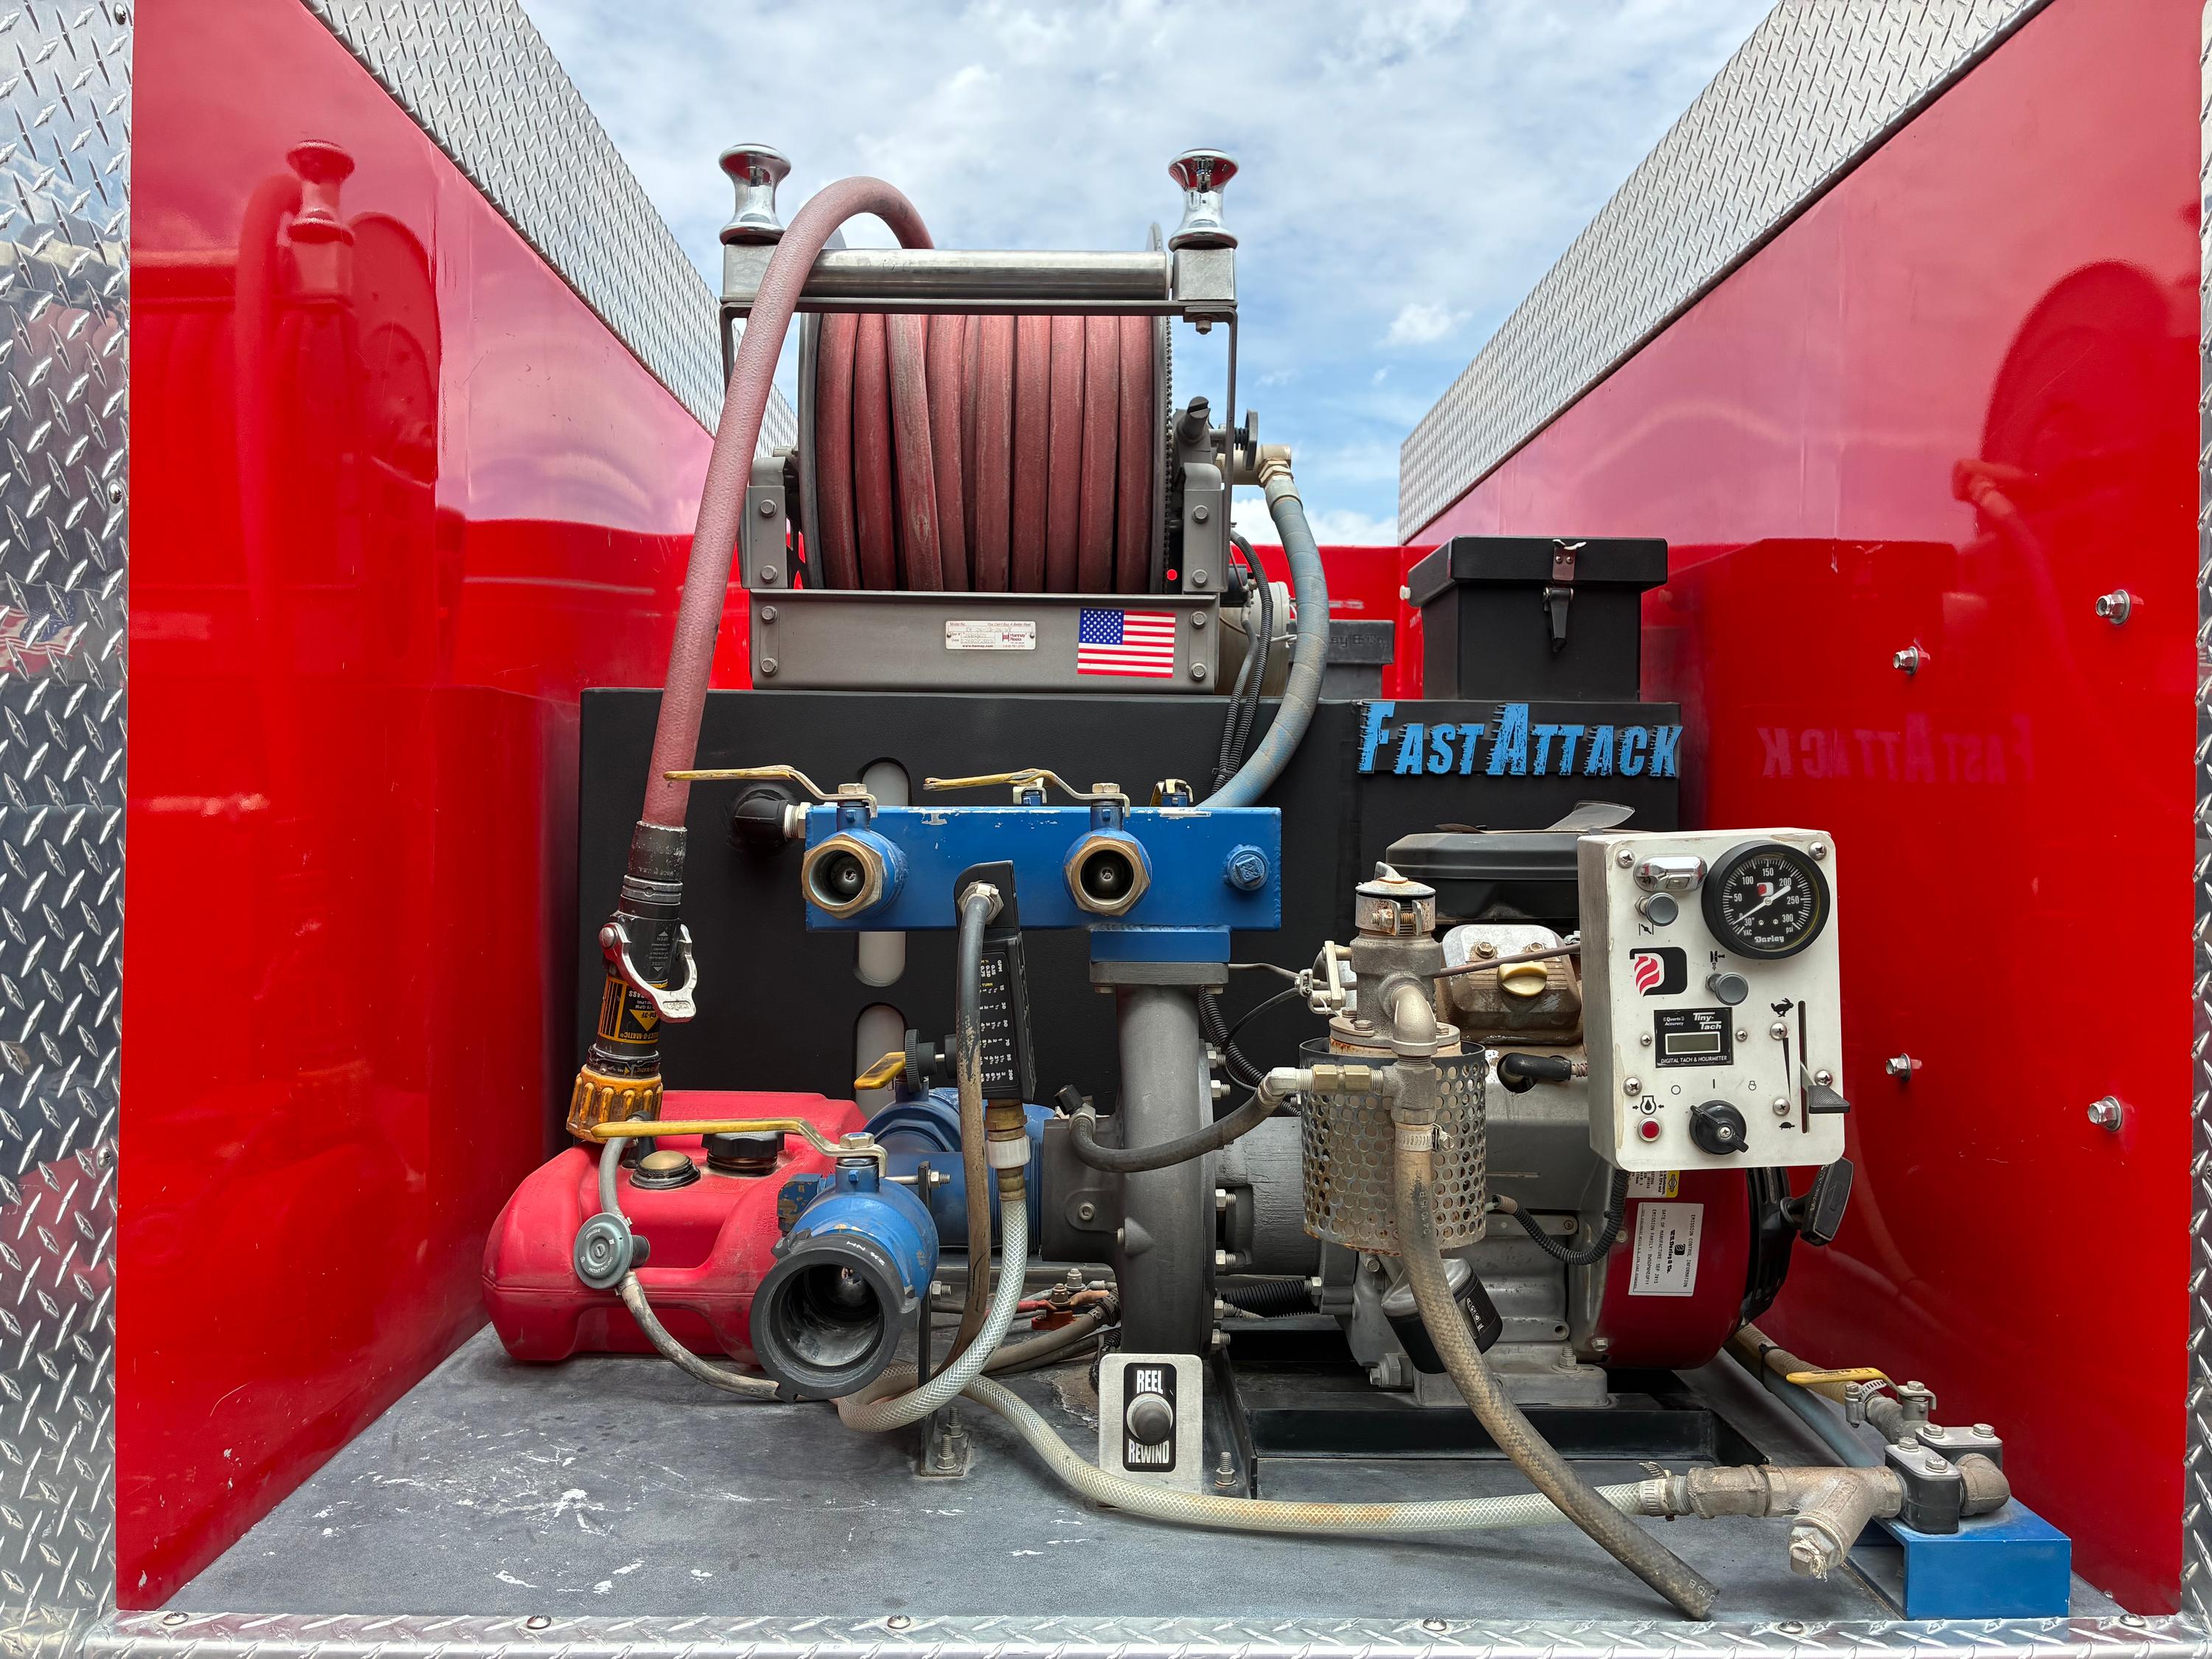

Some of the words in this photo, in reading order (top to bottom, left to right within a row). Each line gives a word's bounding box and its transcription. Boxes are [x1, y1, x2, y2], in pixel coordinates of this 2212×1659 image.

[1357, 701, 1485, 775] FAST
[1486, 703, 1683, 777] ATTACK
[1762, 868, 1774, 877] 150
[1742, 876, 1754, 885] 100
[1779, 877, 1792, 886] 200
[1733, 893, 1742, 902] 50
[1787, 896, 1799, 905] 250
[1782, 914, 1794, 922] 300
[1786, 926, 1794, 934] psi
[1754, 935, 1785, 943] Darley
[1699, 1020, 1722, 1030] Tach
[1005, 1038, 1010, 1046] 70
[1683, 1259, 1691, 1288] INFORMATION
[982, 1346, 995, 1364] JAPAN
[1136, 1369, 1164, 1394] REEL
[1128, 1438, 1169, 1464] REWIND
